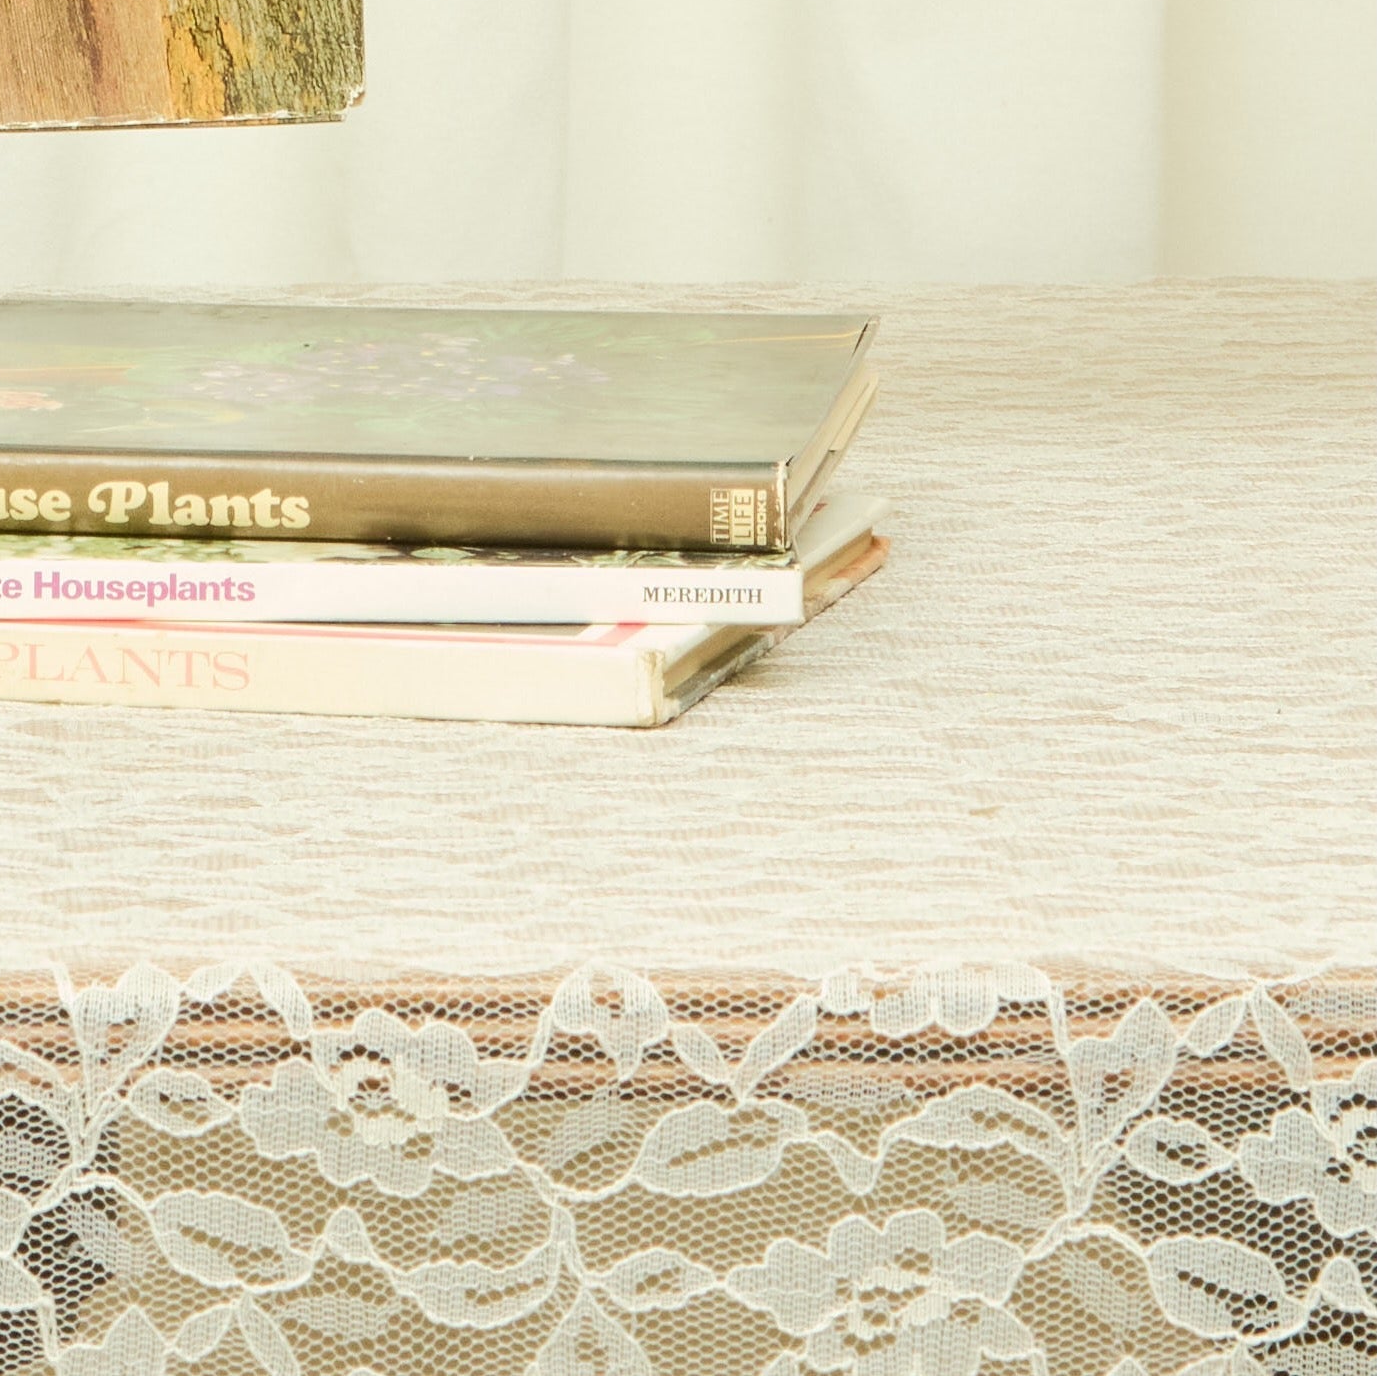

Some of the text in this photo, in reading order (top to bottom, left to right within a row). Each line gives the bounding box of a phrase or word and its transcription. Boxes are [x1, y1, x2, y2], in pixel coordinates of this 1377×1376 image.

[87, 480, 311, 529] Plants
[712, 490, 730, 543] TIME
[734, 495, 752, 538] LIFE
[33, 571, 256, 607] Houseplants
[642, 586, 764, 605] MEREDITH
